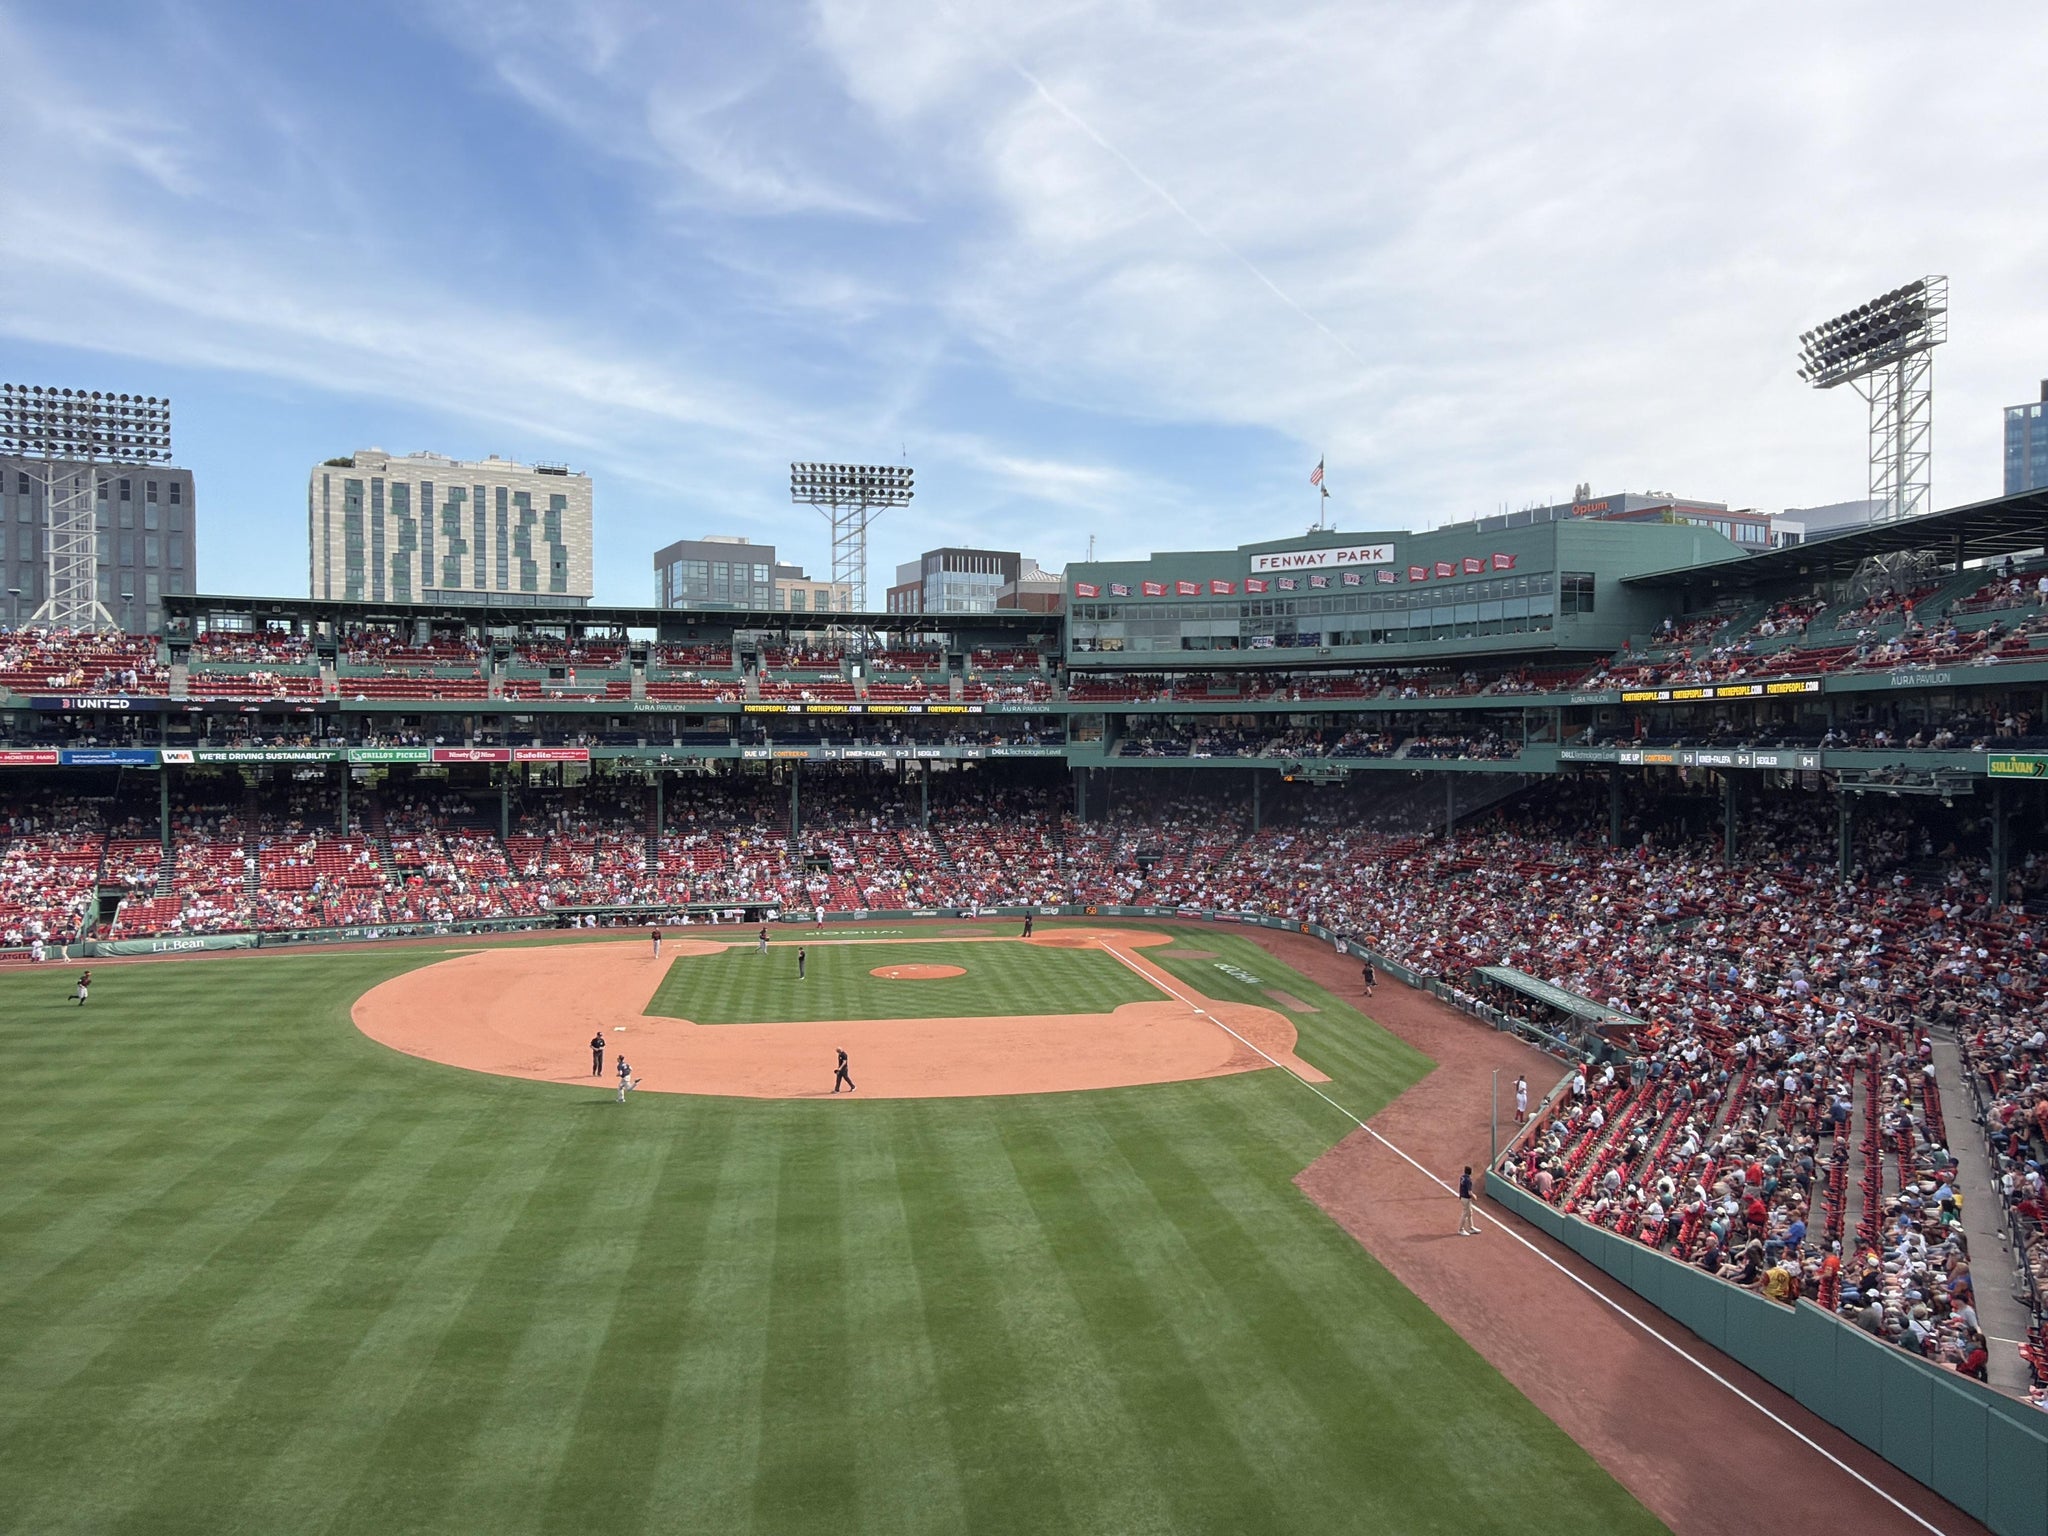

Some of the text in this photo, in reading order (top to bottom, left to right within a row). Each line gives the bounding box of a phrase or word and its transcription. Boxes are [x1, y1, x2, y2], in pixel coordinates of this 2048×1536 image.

[1572, 501, 1608, 515] Optum
[1259, 549, 1383, 568] FENWAY PARK
[1916, 673, 1951, 684] PAVILION
[1717, 685, 1762, 697] FORTHEPEOPLE.COM
[1767, 681, 1819, 694] FORTHEPEOPLE.COM
[1622, 691, 1670, 702] FORTHEPEOPLE.COM
[1673, 688, 1714, 699] FORTHEPEOPLE.COM
[77, 699, 130, 709] UNITED
[867, 705, 922, 713] FORTHEPEOPLE.COM
[927, 705, 982, 713] FORTHEPEOPLE.COM
[229, 752, 264, 760] DRIVING
[396, 751, 427, 759] PICKLES
[516, 751, 551, 759] Safelite
[1620, 753, 1640, 762] DUE UP
[1991, 761, 2033, 774] SULLIVAN
[152, 939, 205, 952] L.L.Bean
